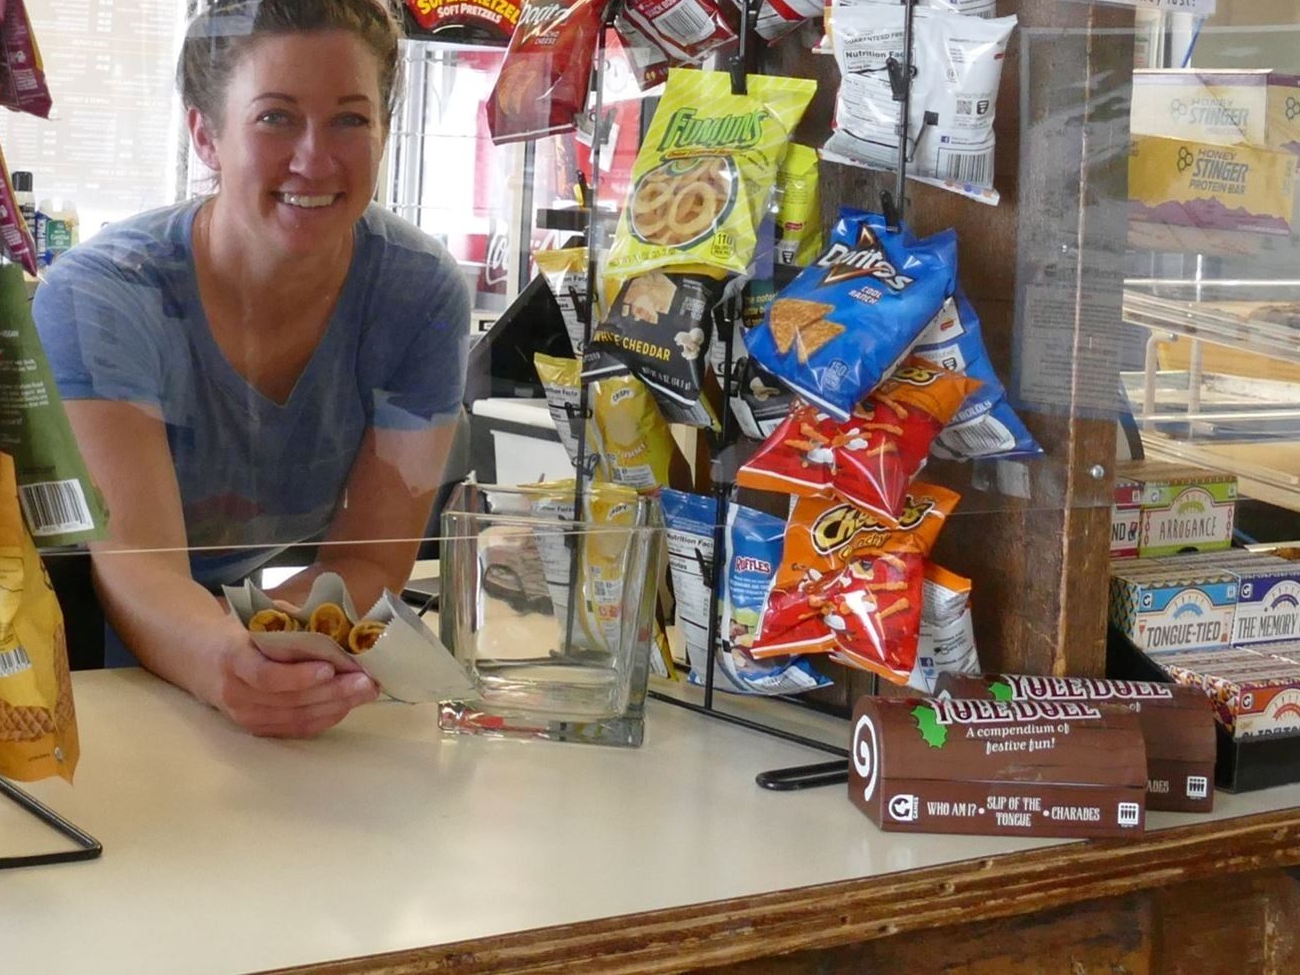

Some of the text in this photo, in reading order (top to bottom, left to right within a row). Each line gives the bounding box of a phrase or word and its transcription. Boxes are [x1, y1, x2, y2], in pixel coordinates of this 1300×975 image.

[437, 4, 501, 24] SOFT PRETZELS
[1198, 149, 1237, 160] HONEY
[1193, 158, 1249, 183] STINGER
[1189, 180, 1245, 194] PROTEIN BAR
[623, 334, 671, 361] CHEDDAR
[1159, 516, 1216, 540] ARROGANCE
[735, 557, 771, 573] RUFFLES
[1238, 613, 1297, 639] THE MEMORY
[1147, 621, 1220, 647] TONGUE-TIED
[931, 699, 1100, 724] YULE DUEL
[966, 723, 1069, 738] A compendium of
[986, 739, 1055, 754] festive fun!
[928, 801, 976, 816] WHO AM I?
[987, 797, 1040, 811] SLIP OF THE
[996, 813, 1031, 826] TONGUE
[1052, 807, 1100, 821] CHARADES
